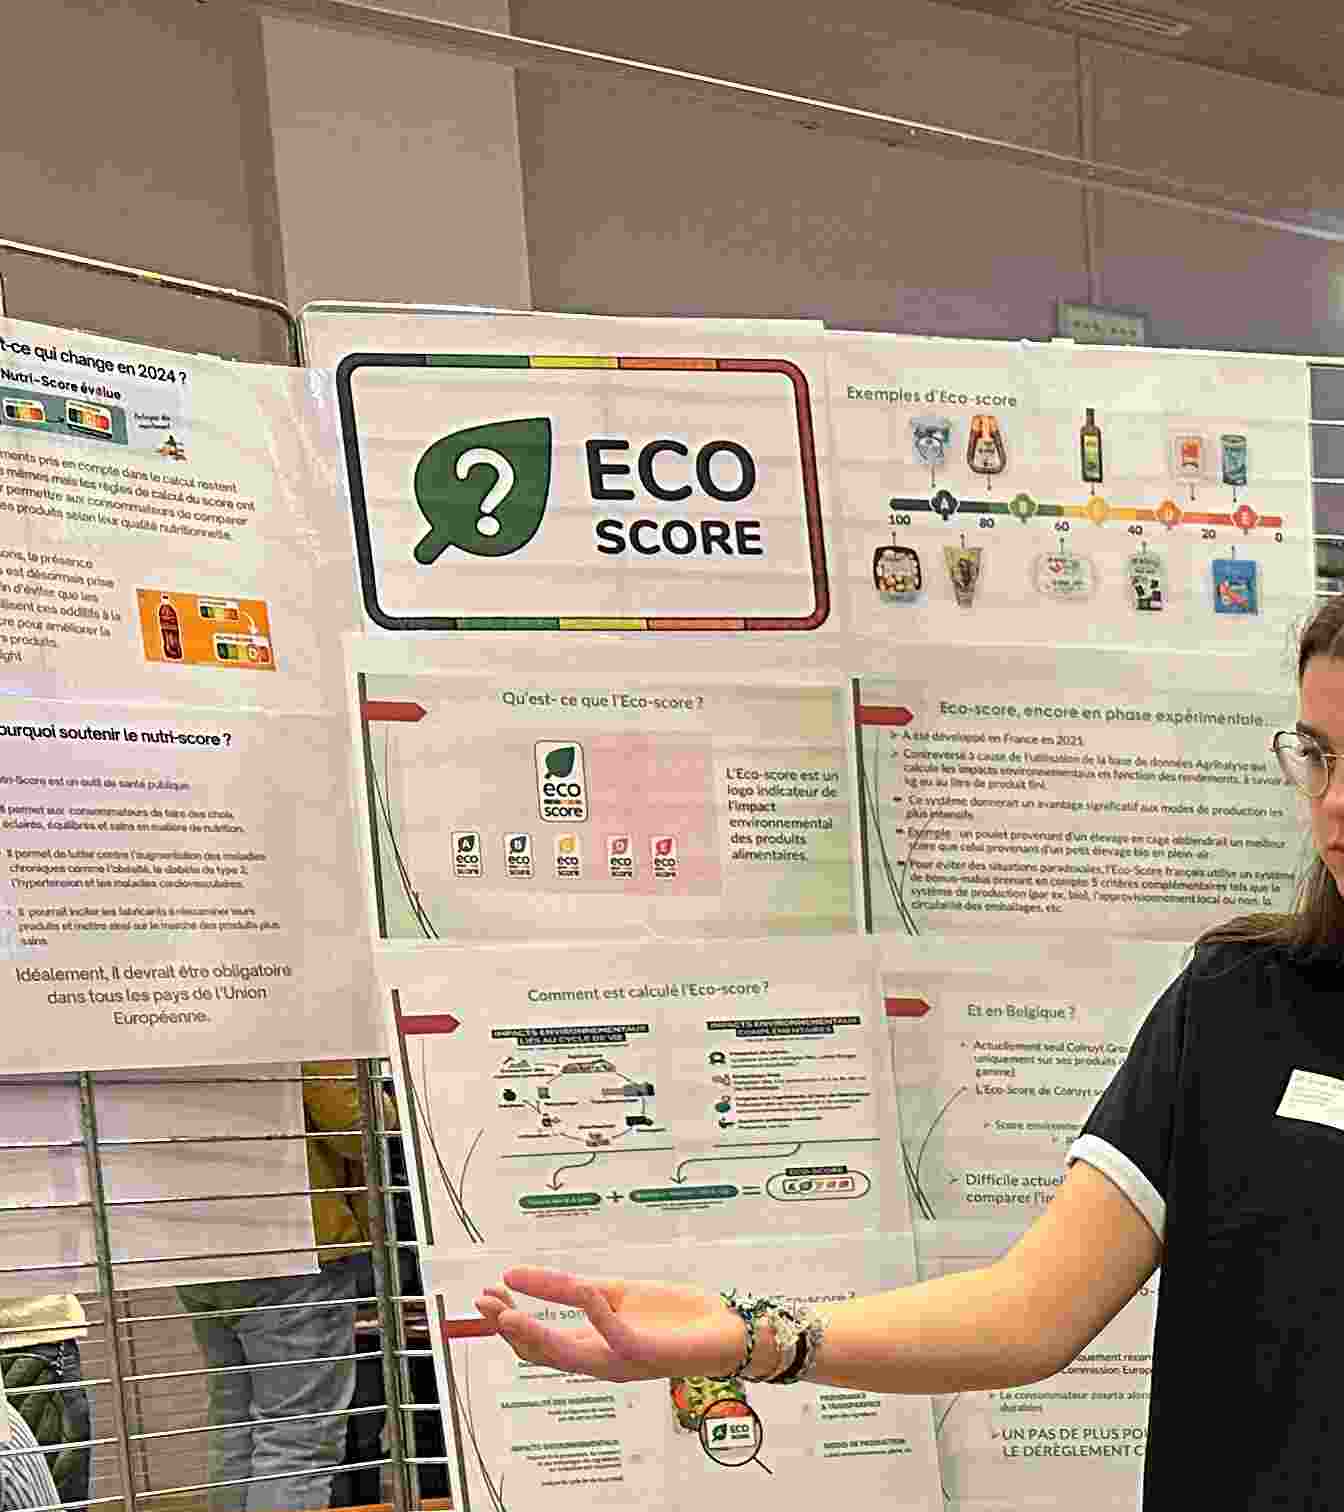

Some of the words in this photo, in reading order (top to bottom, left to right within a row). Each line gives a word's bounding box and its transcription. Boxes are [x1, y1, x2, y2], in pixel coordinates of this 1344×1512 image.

[34, 345, 58, 361] qui
[60, 352, 114, 374] change
[117, 362, 136, 377] en
[138, 363, 176, 383] 2024
[179, 371, 187, 384] ?
[1, 369, 78, 394] Nutri-Score
[846, 385, 919, 404] Exemples
[924, 388, 1018, 408] d'Eco-score
[584, 440, 756, 502] ECO
[889, 514, 912, 527] 100
[979, 517, 994, 530] 80
[1128, 525, 1143, 537] 40
[1201, 528, 1216, 540] 20
[595, 519, 763, 556] SCORE
[581, 696, 608, 710] que
[939, 702, 1021, 720] Eco-score,
[1024, 704, 1079, 719] encore
[1082, 708, 1102, 720] en
[1105, 708, 1152, 726] phase
[59, 726, 121, 744] soutenir
[123, 728, 138, 744] le
[140, 729, 221, 746] nutri-score
[223, 733, 232, 747] ?
[1003, 734, 1038, 745] France
[726, 768, 797, 782] L'Eco-score
[801, 770, 819, 781] est
[823, 772, 839, 782] un
[542, 782, 581, 797] eco
[728, 784, 754, 800] logo
[757, 782, 818, 798] indicateur
[821, 785, 837, 798] de
[543, 804, 583, 818] score
[728, 800, 776, 816] l'impact
[729, 815, 833, 831] environnemental
[731, 832, 750, 845] des
[755, 832, 807, 847] produits
[456, 855, 478, 864] eco
[508, 855, 530, 865] eco
[557, 856, 578, 866] eco
[610, 857, 632, 866] eco
[654, 857, 676, 867] eco
[16, 965, 110, 984] Idéalement,
[124, 963, 175, 980] devrait
[179, 964, 211, 979] être
[214, 964, 293, 982] obligatoire
[48, 988, 86, 1005] dans
[90, 988, 123, 1003] tous
[126, 988, 149, 1003] les
[154, 991, 189, 1011] pays
[193, 988, 211, 1001] de
[215, 986, 267, 1001] l'Union
[527, 986, 599, 1003] Comment
[602, 987, 625, 1001] est
[628, 984, 679, 1000] calculé
[113, 1009, 211, 1027] Européenne.
[968, 1004, 981, 1017] Et
[985, 1007, 1001, 1017] en
[1007, 1004, 1064, 1020] Belgique
[1067, 1004, 1075, 1017] ?
[966, 1173, 1018, 1187] Difficile
[966, 1192, 1032, 1206] comparer
[1002, 1428, 1024, 1441] UN
[1028, 1428, 1056, 1441] PAS
[1060, 1428, 1080, 1441] DE
[1083, 1428, 1119, 1441] PLUS
[1122, 1428, 1148, 1441] PO
[1002, 1445, 1019, 1457] LE
